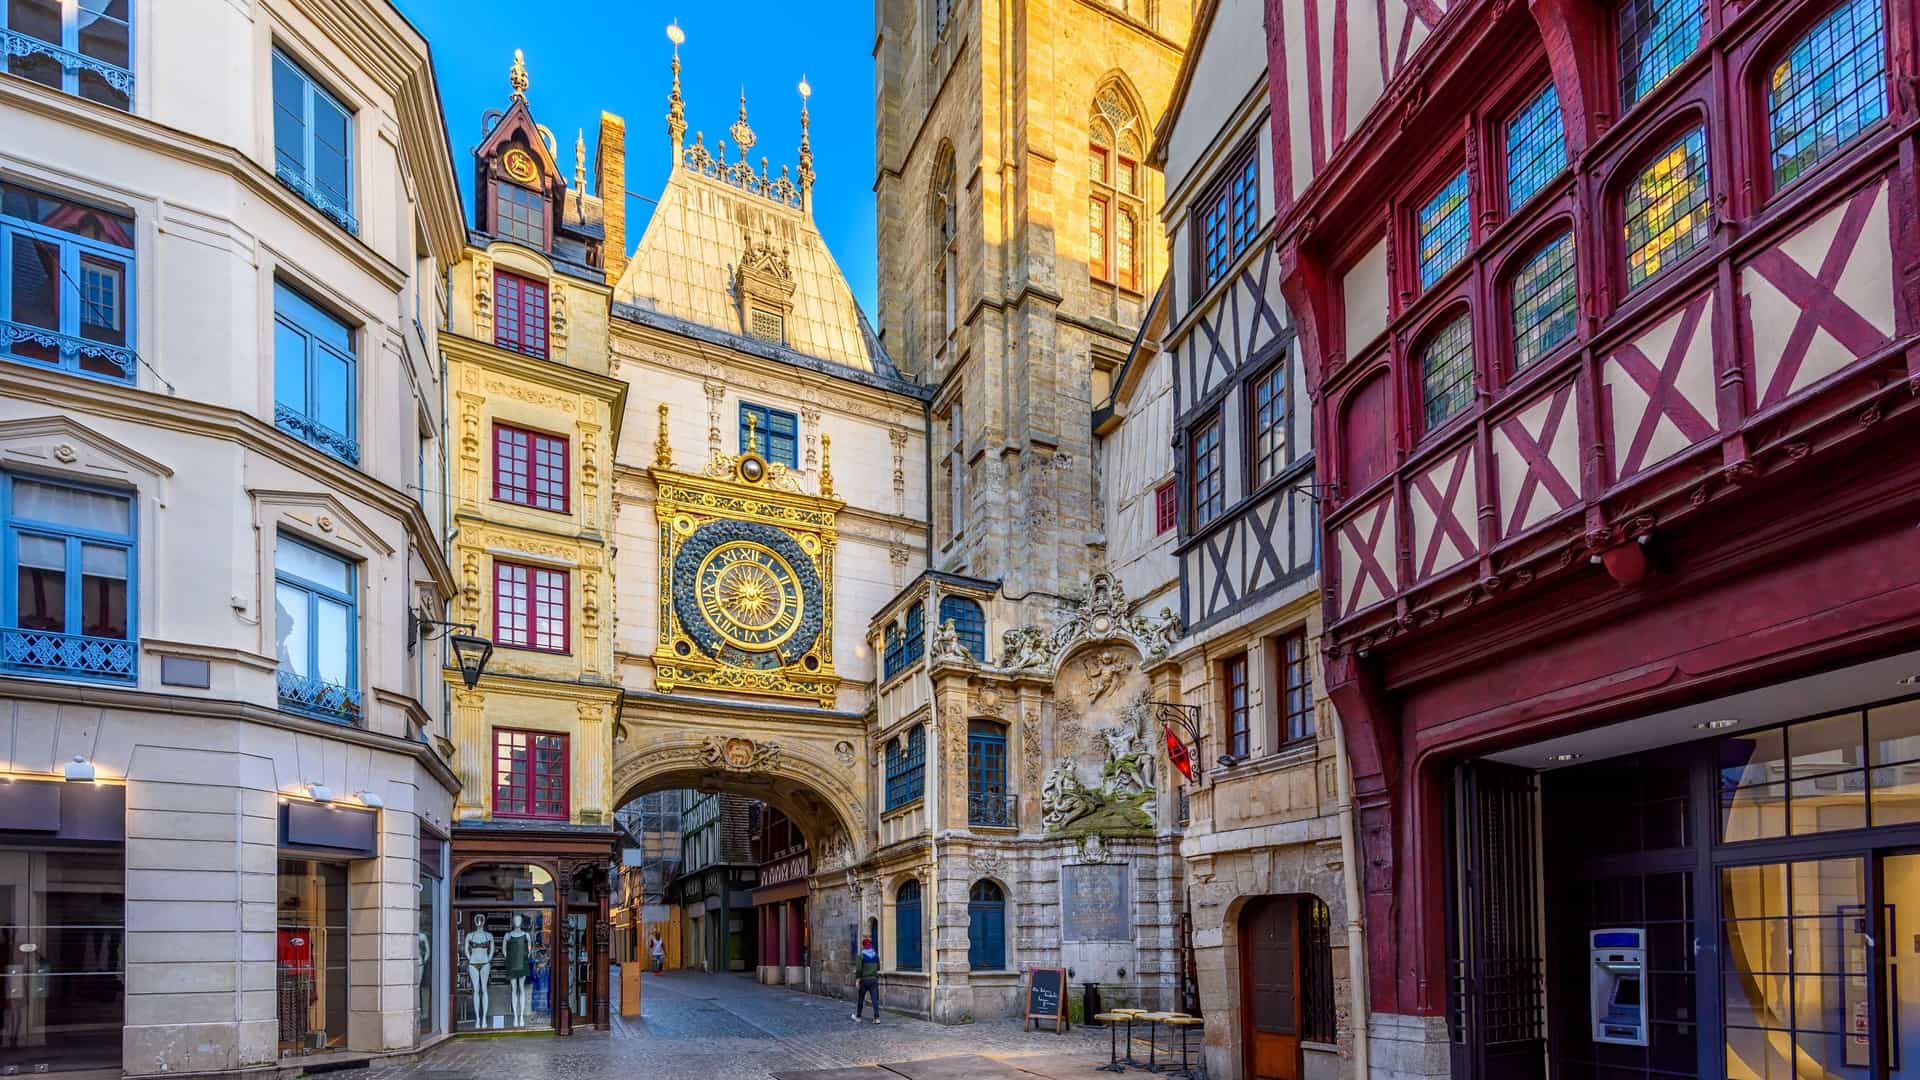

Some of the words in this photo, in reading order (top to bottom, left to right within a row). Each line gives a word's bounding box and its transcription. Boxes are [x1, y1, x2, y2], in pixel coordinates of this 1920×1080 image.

[720, 549, 737, 565] XI
[740, 548, 759, 561] XII
[706, 562, 720, 577] X
[779, 576, 791, 584] II
[703, 582, 714, 597] IX
[786, 596, 797, 607] III
[721, 620, 738, 638] VII
[768, 629, 778, 640] V
[745, 630, 759, 642] VI
